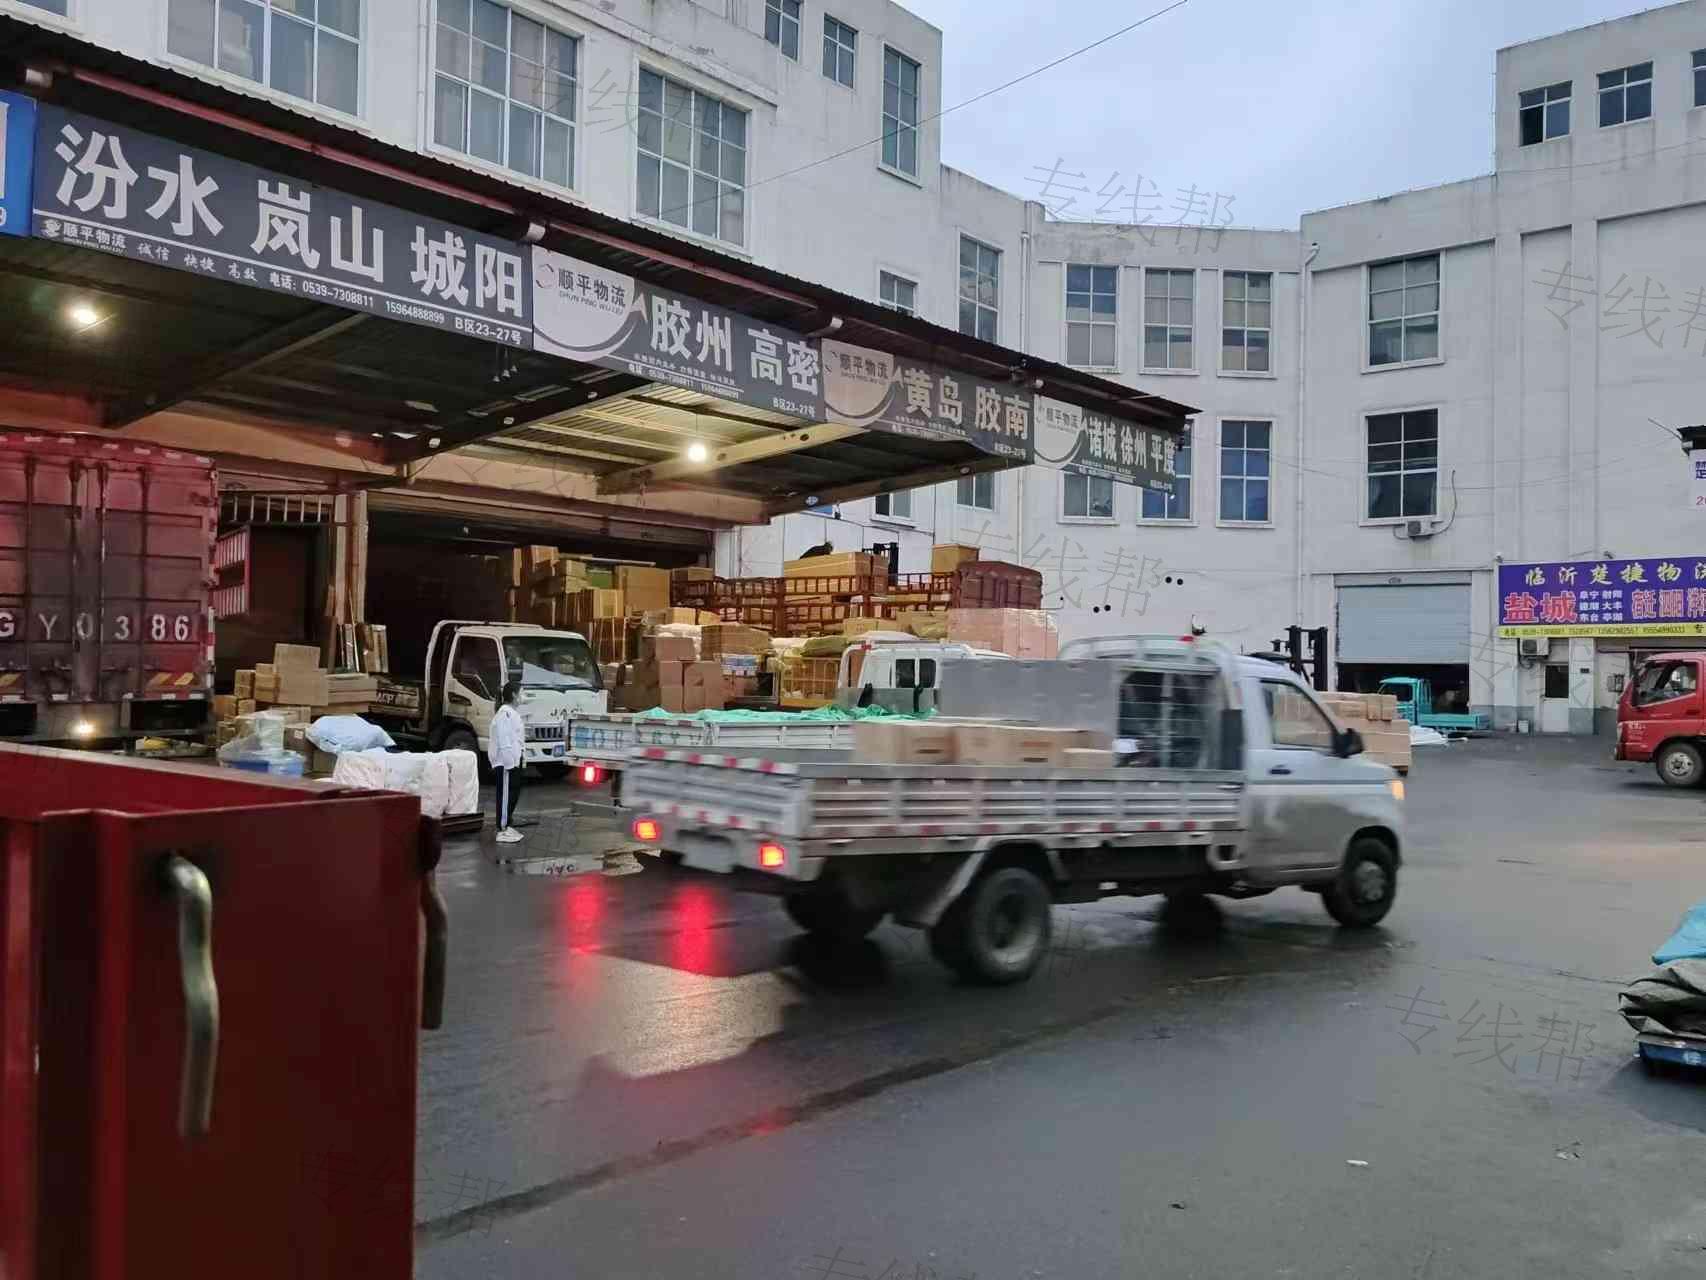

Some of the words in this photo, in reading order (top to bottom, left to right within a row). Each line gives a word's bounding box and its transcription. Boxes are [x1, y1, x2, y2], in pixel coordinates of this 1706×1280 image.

[55, 124, 224, 236] 汾水
[250, 179, 384, 283] 岚山
[410, 225, 523, 318] 城阳
[63, 222, 126, 249] 顺平物流
[559, 267, 626, 308] 顺平物流
[650, 295, 733, 373] 胶州
[747, 327, 819, 396] 高密
[903, 367, 963, 427] 黄岛
[974, 384, 1030, 440] 胶南
[1121, 425, 1147, 470] 徐州
[1151, 434, 1176, 477] 平度
[1503, 590, 1578, 625] 盐城
